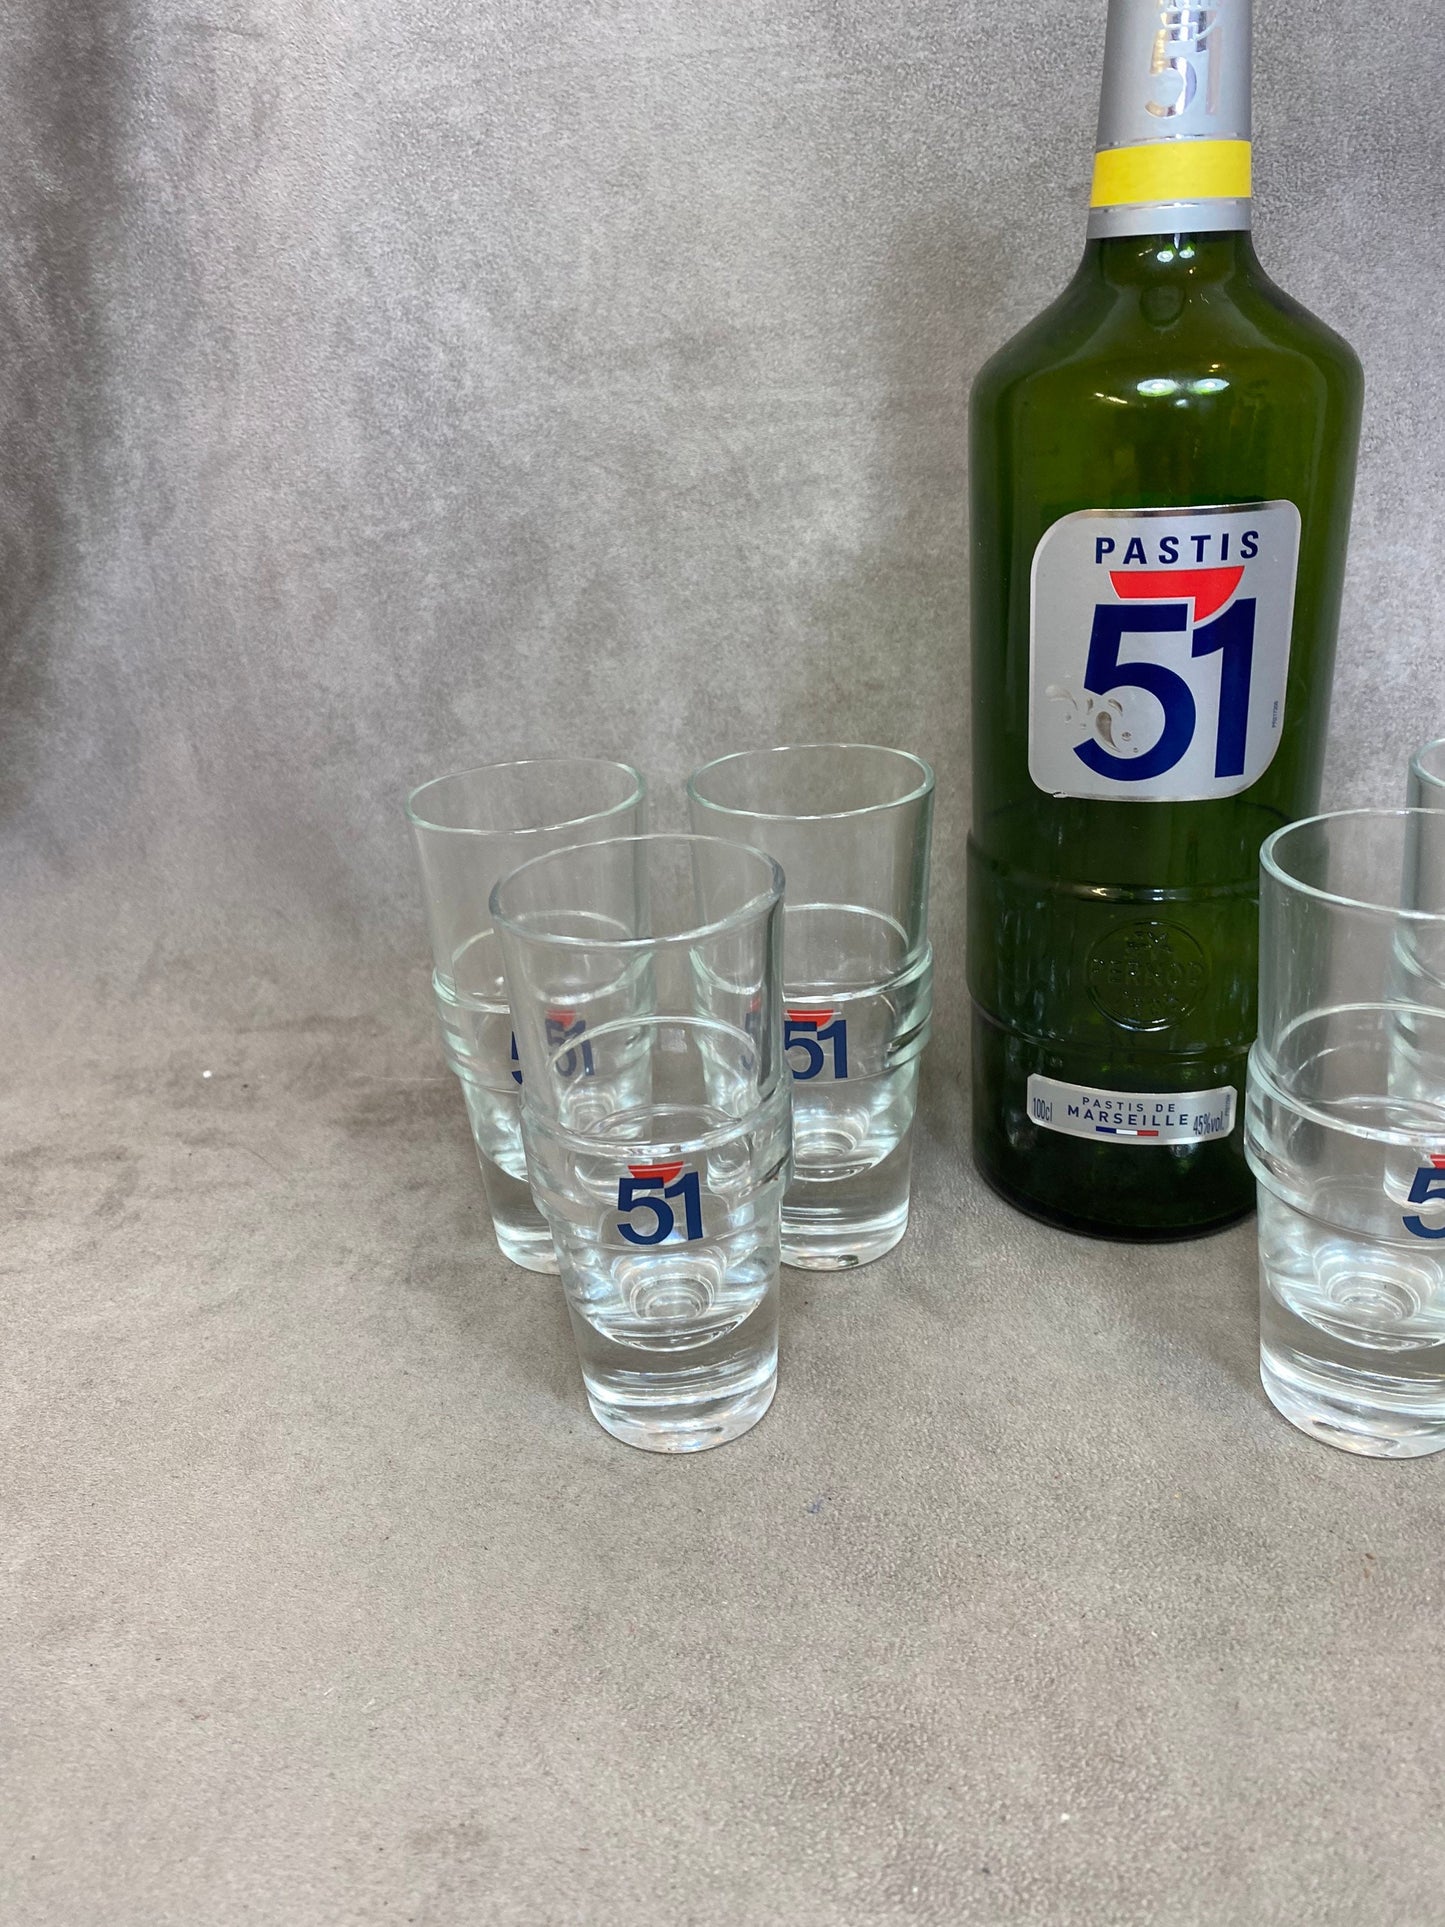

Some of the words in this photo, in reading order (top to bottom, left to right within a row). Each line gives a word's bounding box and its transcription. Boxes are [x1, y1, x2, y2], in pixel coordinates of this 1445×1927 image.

[1095, 530, 1259, 565] PASTIS
[1073, 597, 1257, 782] 51
[784, 1019, 848, 1080] 51
[1032, 1097, 1053, 1122] 100cl
[1067, 1104, 1188, 1126] MARSEILLE
[1082, 1096, 1144, 1112] PASTIS
[1155, 1103, 1176, 1113] DE
[616, 1171, 704, 1246] 51
[1402, 1167, 1445, 1239] 5
